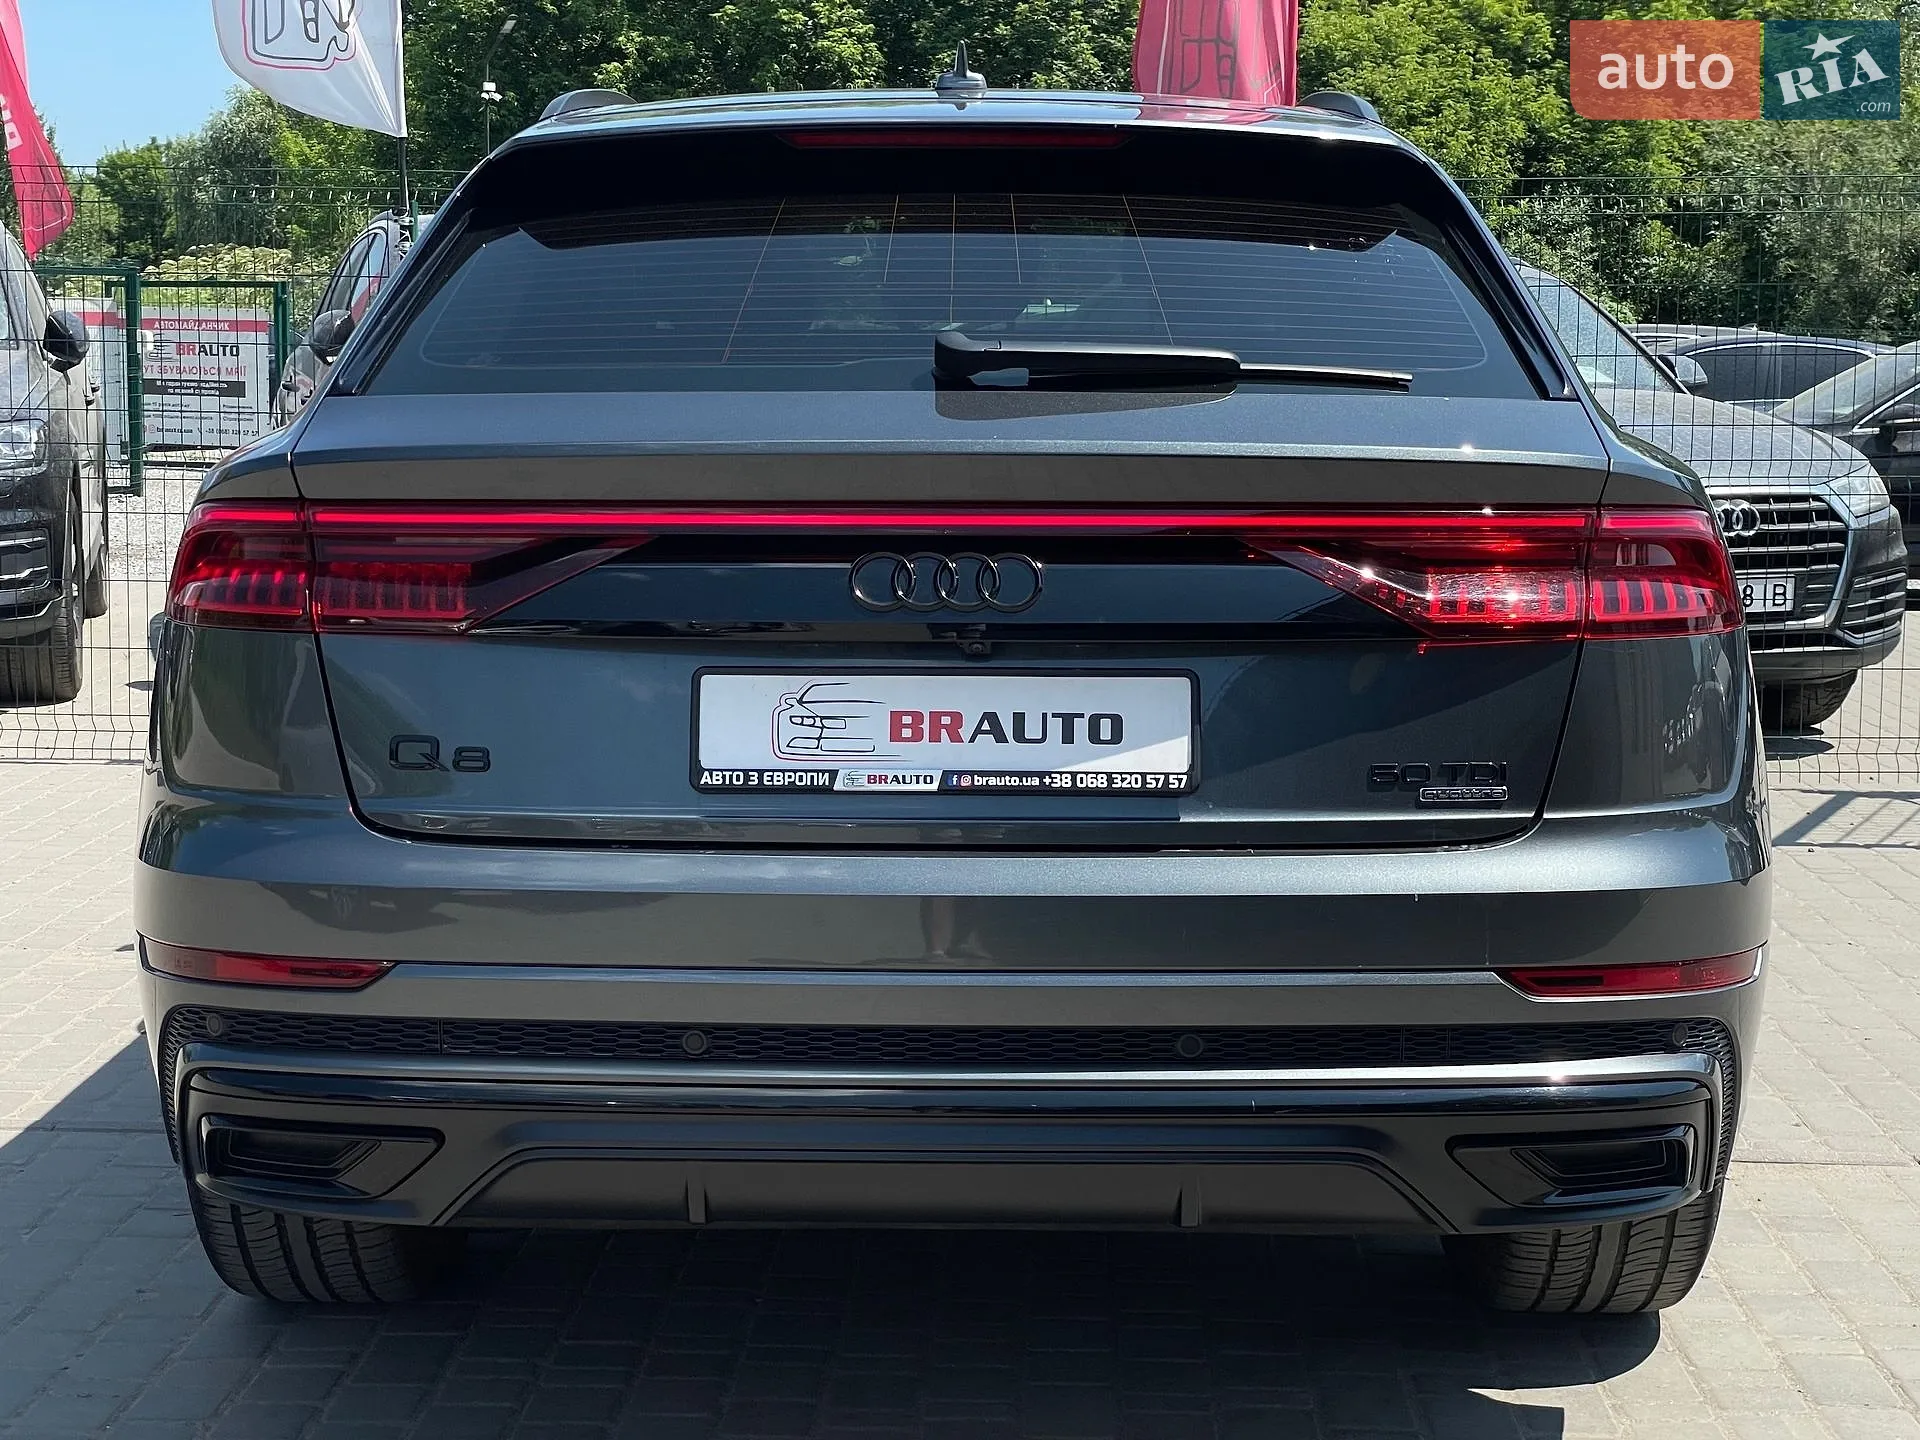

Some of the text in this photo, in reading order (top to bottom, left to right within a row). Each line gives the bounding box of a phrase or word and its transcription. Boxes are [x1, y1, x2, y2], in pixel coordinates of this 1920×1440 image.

[176, 343, 239, 357] BRAUTO
[889, 710, 1124, 745] BRAUTO
[389, 734, 491, 772] Q8
[700, 771, 744, 786] АВТО
[763, 772, 830, 786] ЄВРОПИ
[867, 774, 934, 785] BRAUTO
[1370, 762, 1507, 782] 50 TDI
[974, 774, 1040, 786] brauto.ua
[1043, 773, 1072, 788] +38
[1076, 774, 1108, 788] 068
[1112, 774, 1142, 788] 320
[1146, 774, 1165, 789] 57
[1169, 774, 1188, 789] 57
[1424, 788, 1504, 800] quattro
